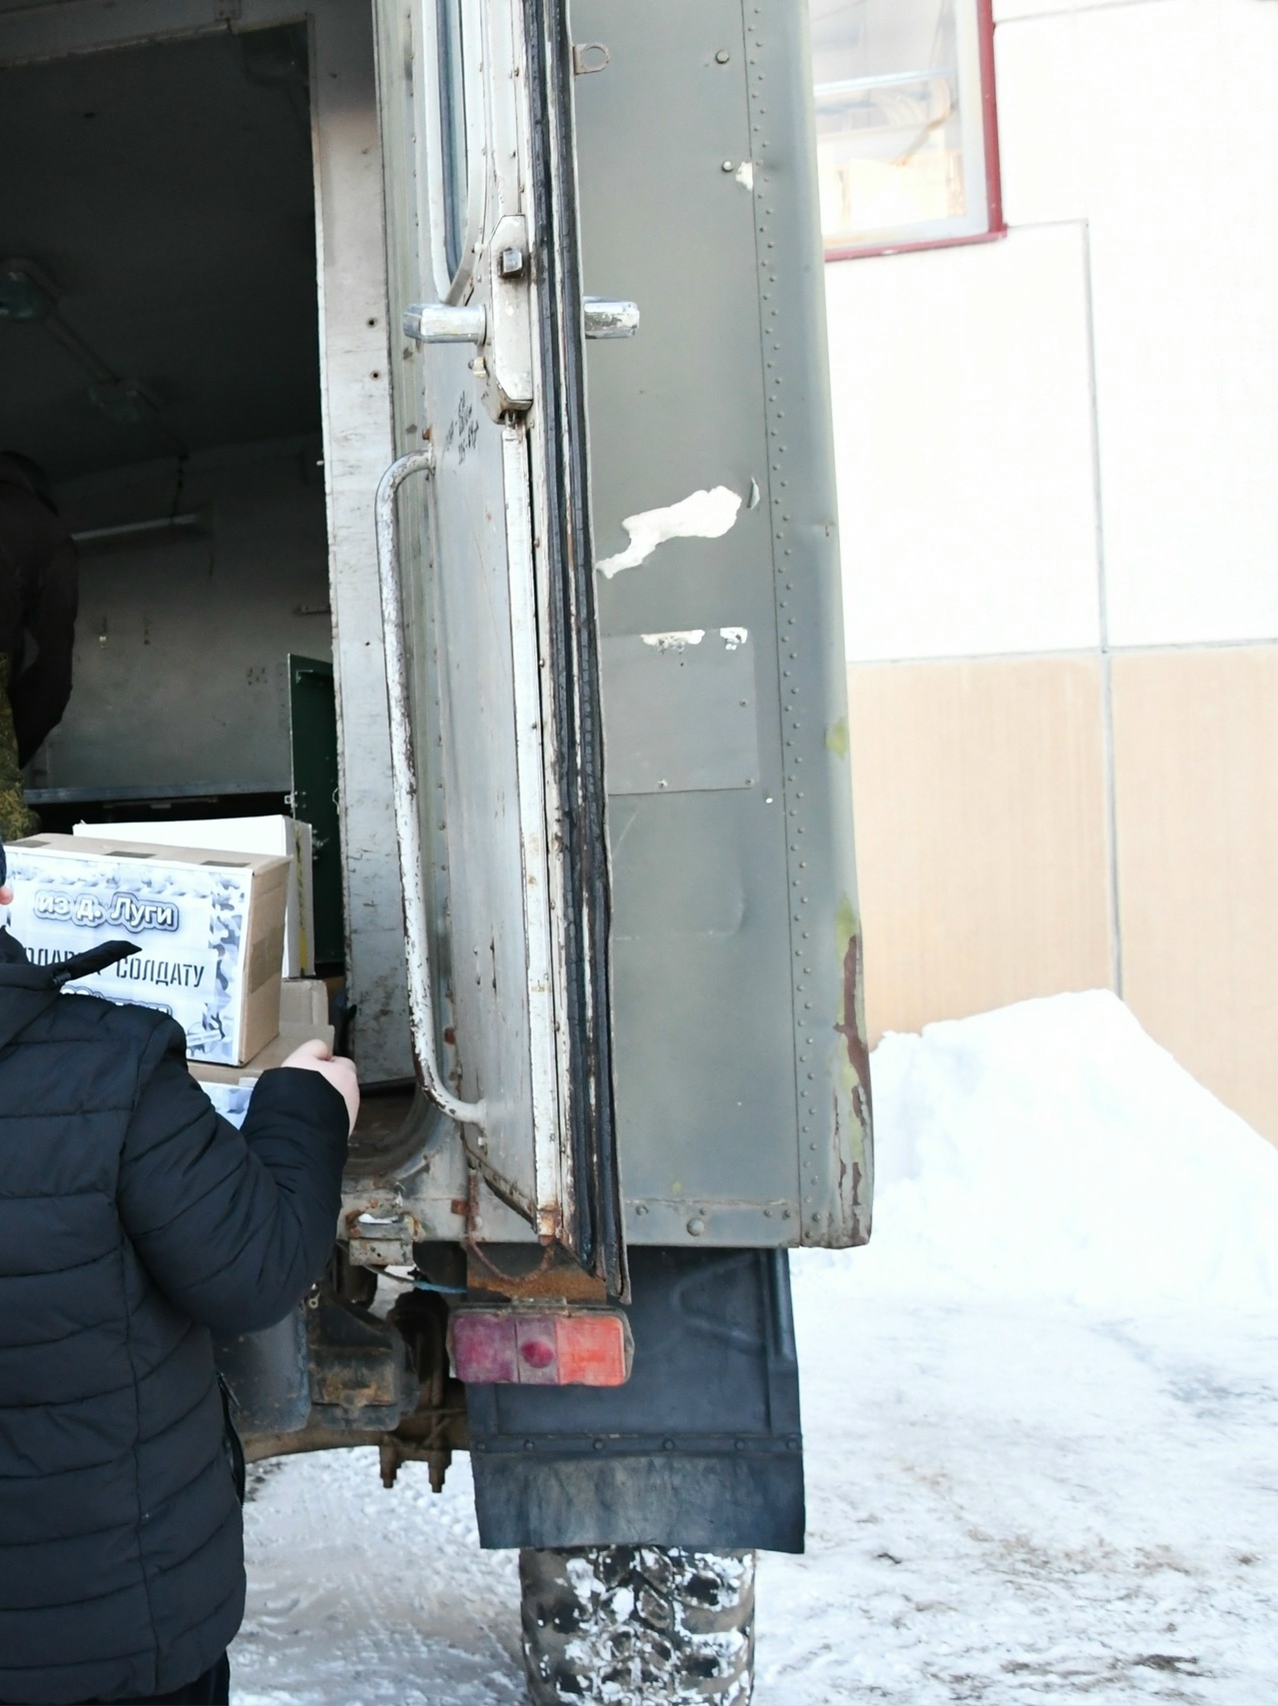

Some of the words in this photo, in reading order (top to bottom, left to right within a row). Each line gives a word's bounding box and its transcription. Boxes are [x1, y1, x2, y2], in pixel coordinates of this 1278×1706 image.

[37, 894, 70, 916] из
[110, 896, 174, 928] Луги
[116, 957, 205, 988] СОЛДАТУ
